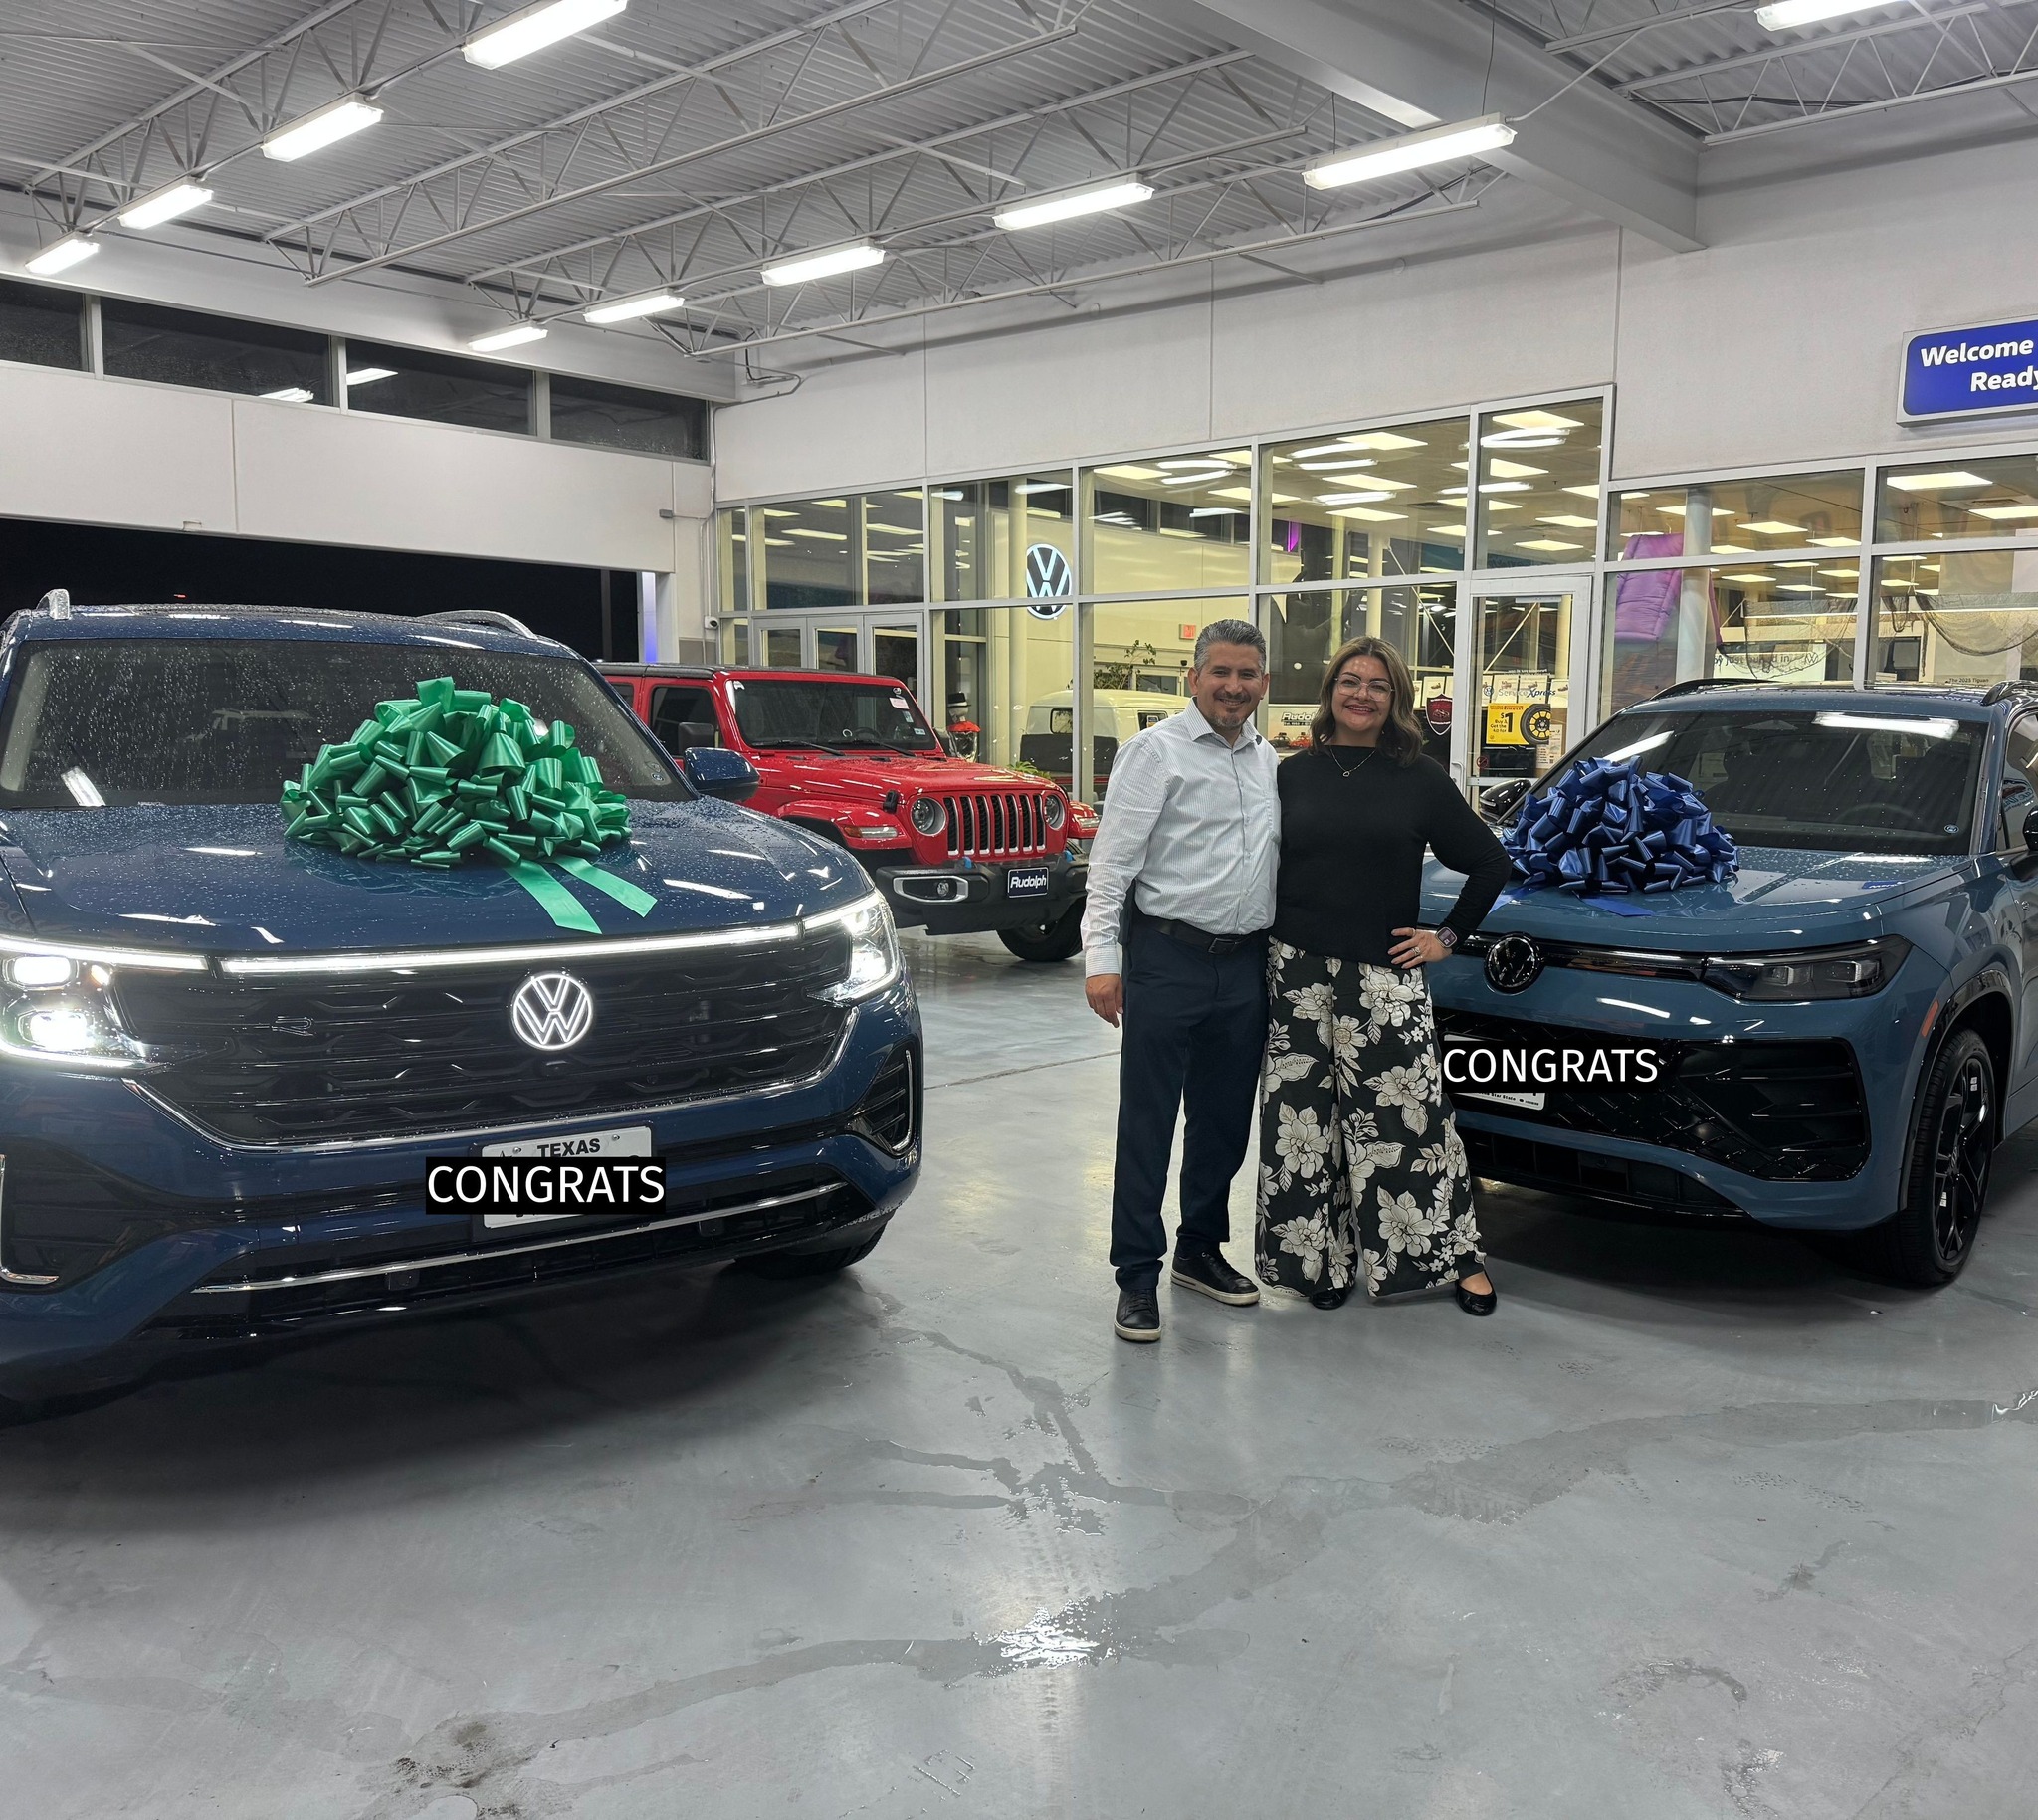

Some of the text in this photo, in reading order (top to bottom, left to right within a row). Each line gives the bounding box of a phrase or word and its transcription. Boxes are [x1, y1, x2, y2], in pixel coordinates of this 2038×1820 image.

[1920, 339, 2034, 367] Welcome
[1281, 711, 1316, 722] Rudol
[1010, 875, 1047, 889] Rudolph
[514, 974, 591, 1049] VW
[537, 1138, 601, 1157] TEXAS
